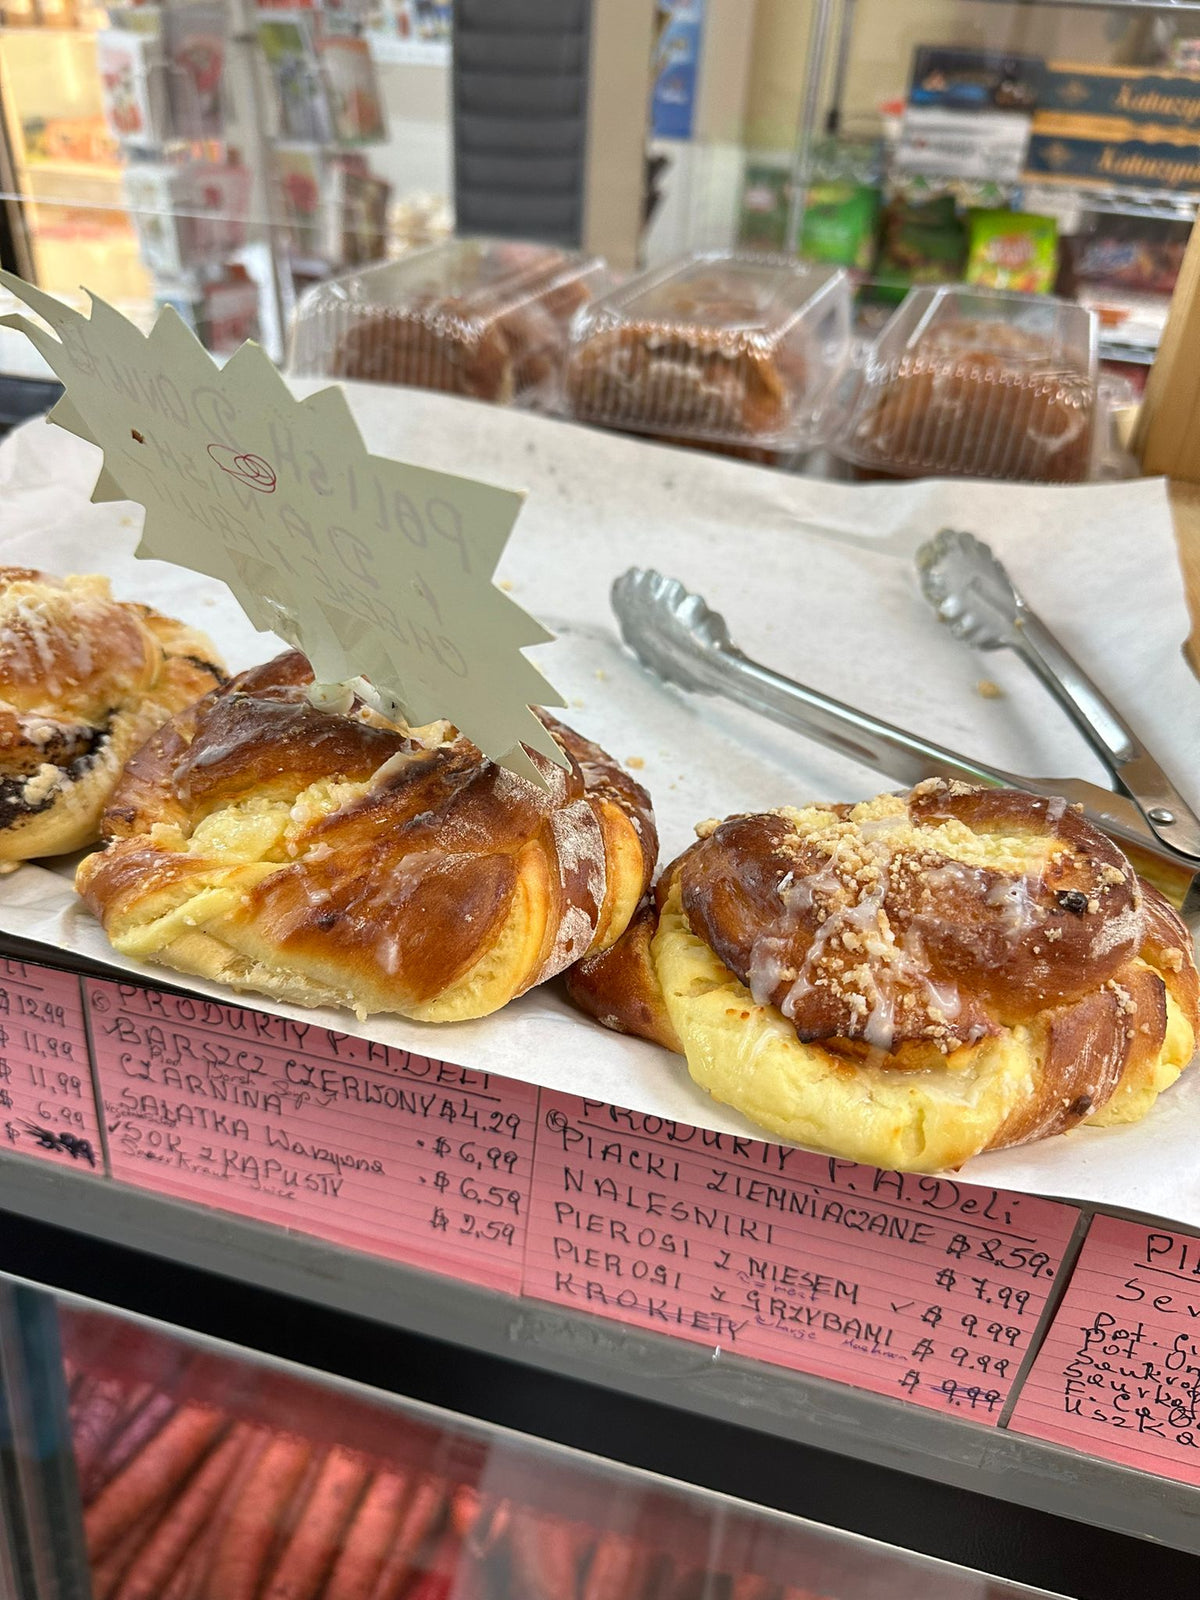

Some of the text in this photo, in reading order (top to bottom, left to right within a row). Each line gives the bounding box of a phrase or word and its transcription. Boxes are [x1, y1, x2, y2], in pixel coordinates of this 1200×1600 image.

[115, 1017, 268, 1076] BARSZCZ
[285, 1058, 437, 1118] CZERWONY
[120, 1053, 283, 1116] CZARNINA
[124, 1121, 182, 1153] SOK
[222, 1147, 344, 1198] KAPUSTY
[564, 1166, 773, 1244] NALESNIKI
[1146, 1234, 1200, 1275] PI
